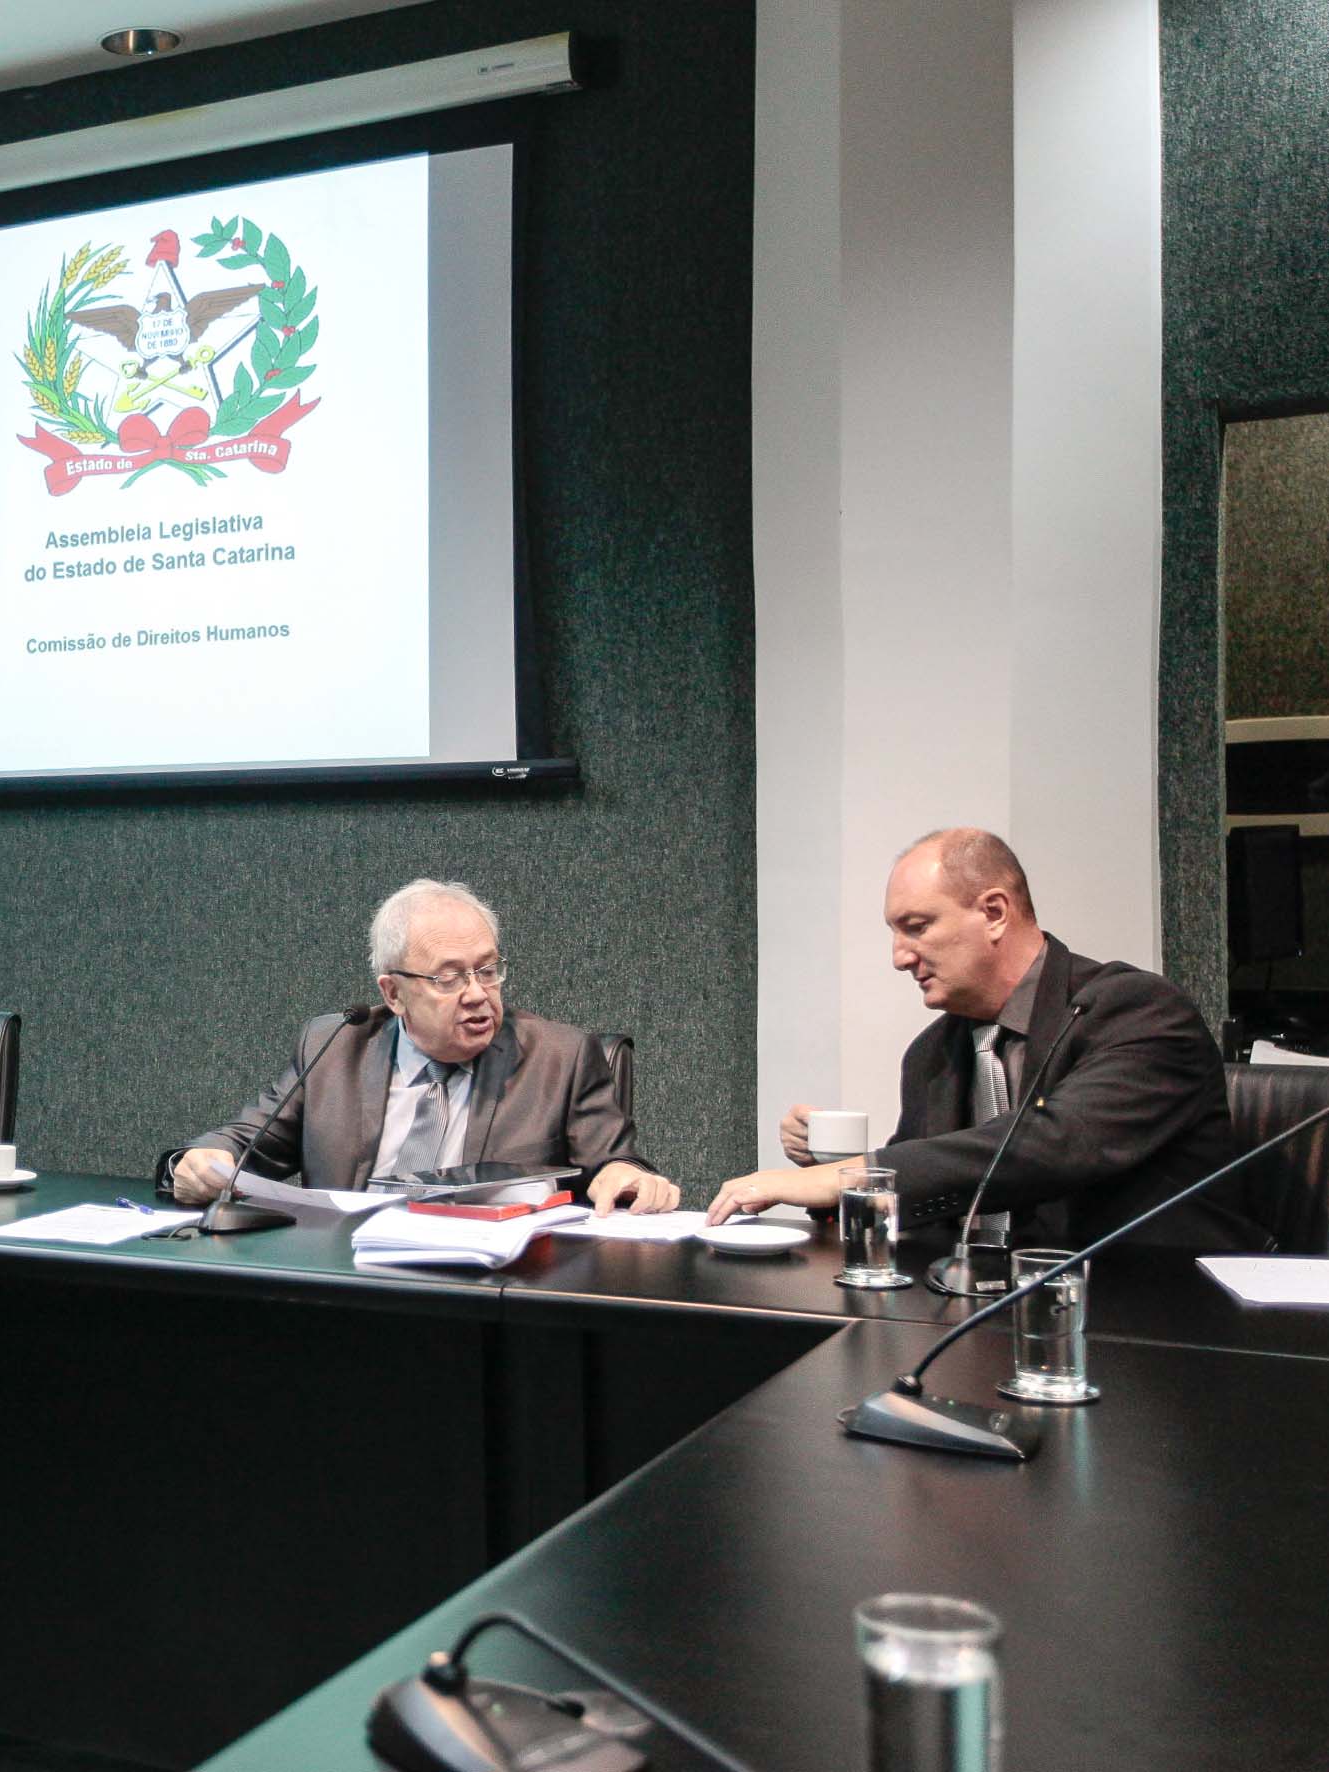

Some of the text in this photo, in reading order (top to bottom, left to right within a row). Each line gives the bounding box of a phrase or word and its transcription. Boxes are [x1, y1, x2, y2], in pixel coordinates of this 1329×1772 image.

[185, 440, 279, 461] Sta. Catarina
[66, 458, 133, 476] Estado de
[45, 514, 263, 549] Assembleia Legislativa
[24, 543, 295, 582] do Estado de Santa Catarina
[27, 625, 290, 654] Comissão de Direitos Humanos
